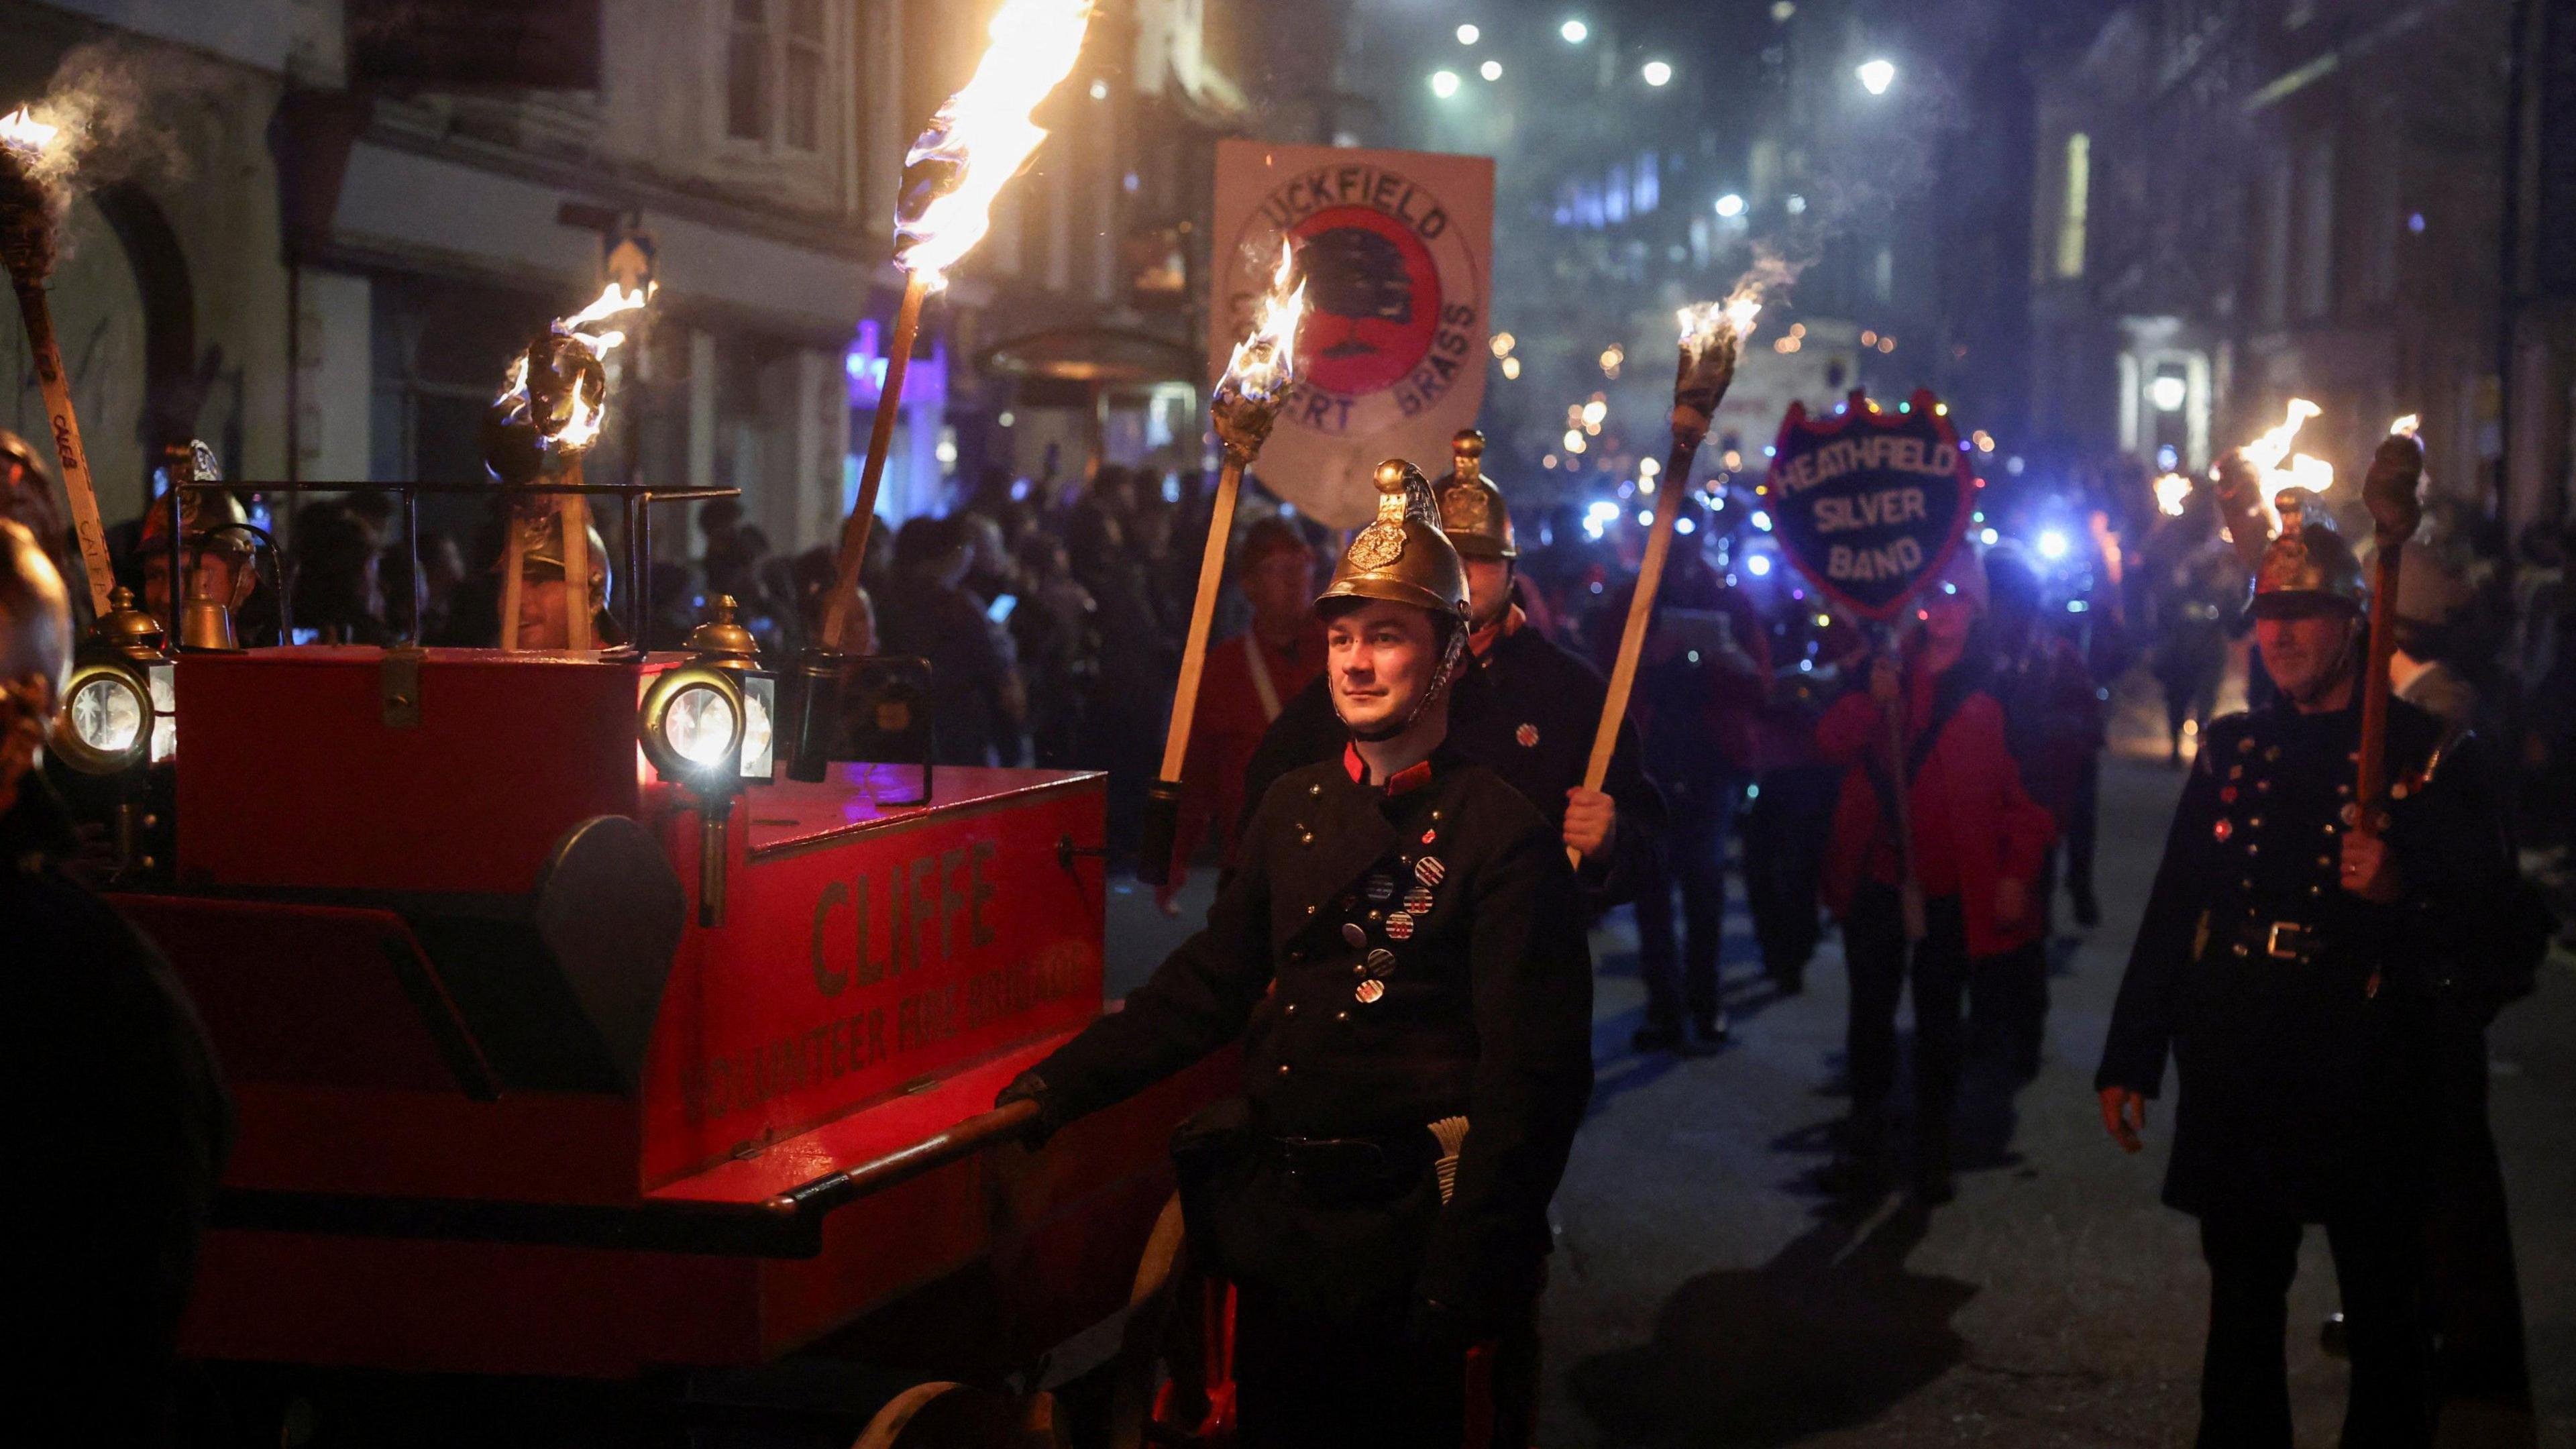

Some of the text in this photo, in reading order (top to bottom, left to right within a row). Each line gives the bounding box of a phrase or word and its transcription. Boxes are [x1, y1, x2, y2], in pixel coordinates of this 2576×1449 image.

[1261, 168, 1447, 241] UCKFIELD
[1396, 304, 1474, 417] BRASS
[54, 414, 78, 469] CALEB
[1774, 436, 1957, 498] HEATHFIELD
[1814, 487, 1926, 533] SILVER
[1827, 537, 1923, 580] BAND
[810, 840, 997, 998] CLIFFE
[897, 981, 959, 1052] FIRE
